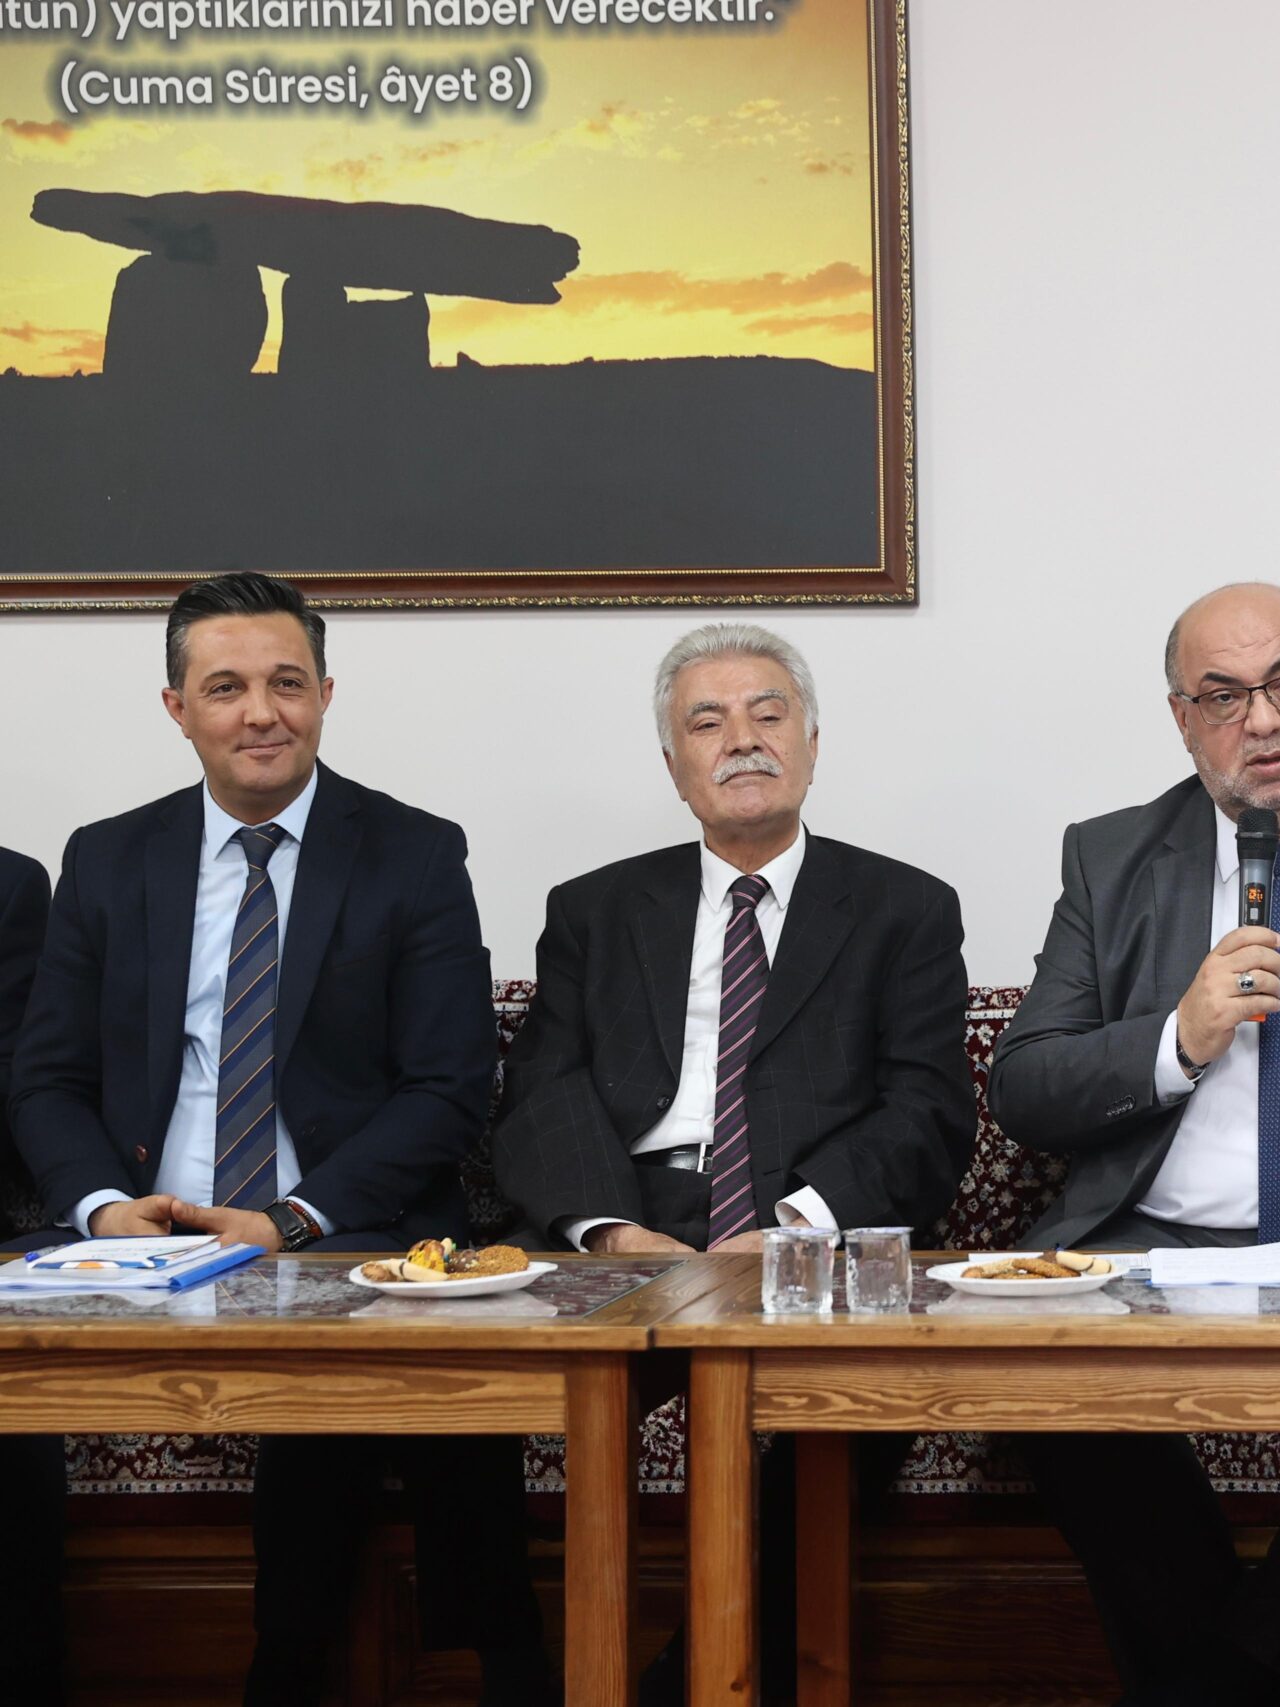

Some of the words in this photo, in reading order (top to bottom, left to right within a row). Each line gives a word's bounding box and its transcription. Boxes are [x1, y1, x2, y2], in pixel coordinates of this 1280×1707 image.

[0, 0, 97, 38] tün)
[406, 0, 535, 27] haber
[61, 60, 214, 114] (Cuma
[225, 64, 369, 109] Sûresi,
[380, 65, 478, 114] âyet
[488, 56, 532, 110] 8)
